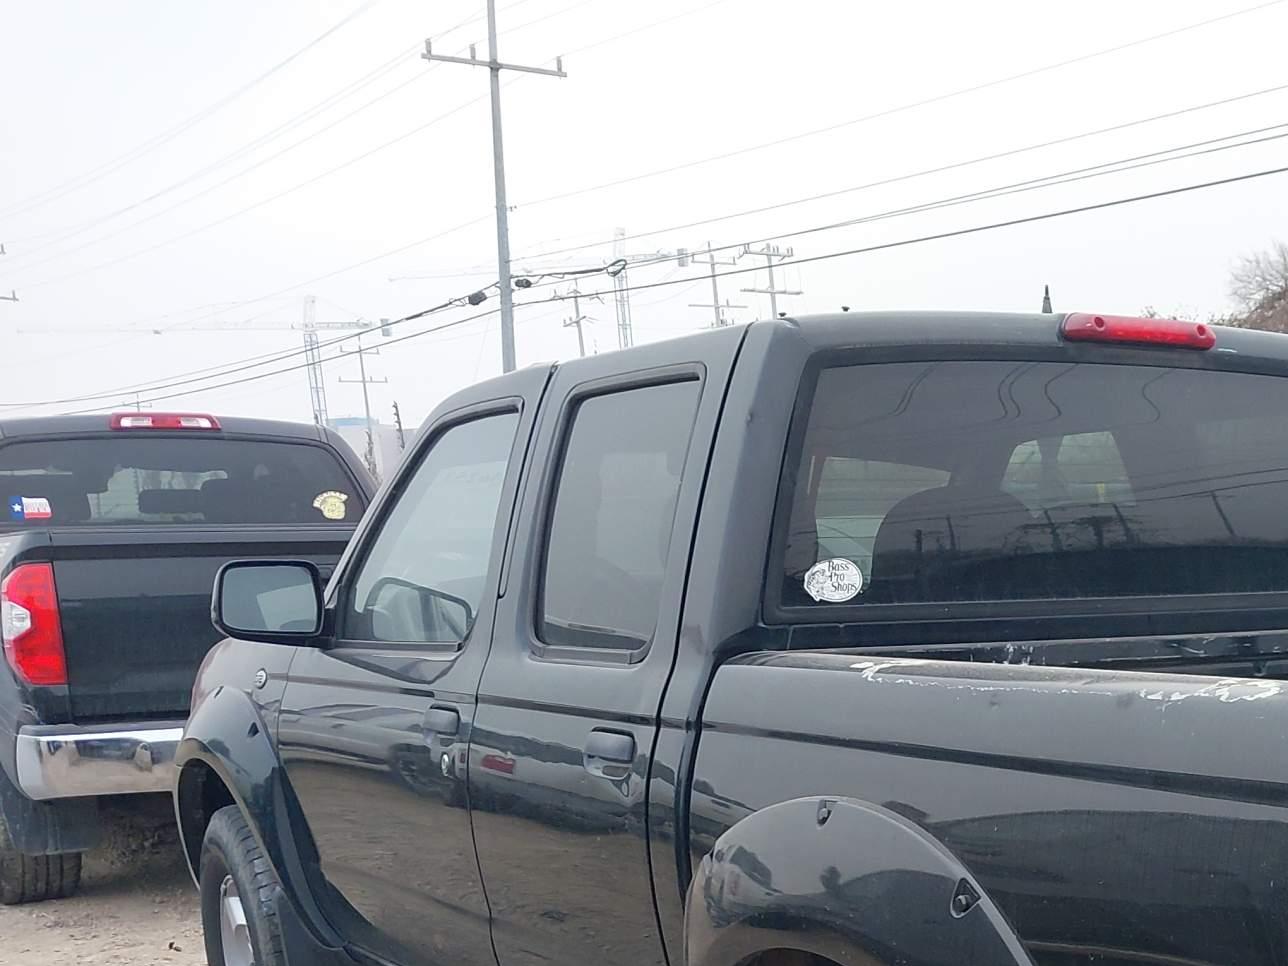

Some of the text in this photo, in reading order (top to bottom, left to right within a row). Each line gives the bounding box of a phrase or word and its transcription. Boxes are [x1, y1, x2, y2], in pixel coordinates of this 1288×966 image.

[827, 560, 850, 572] Bass
[828, 572, 845, 582] Pro
[831, 582, 857, 594] Shops
